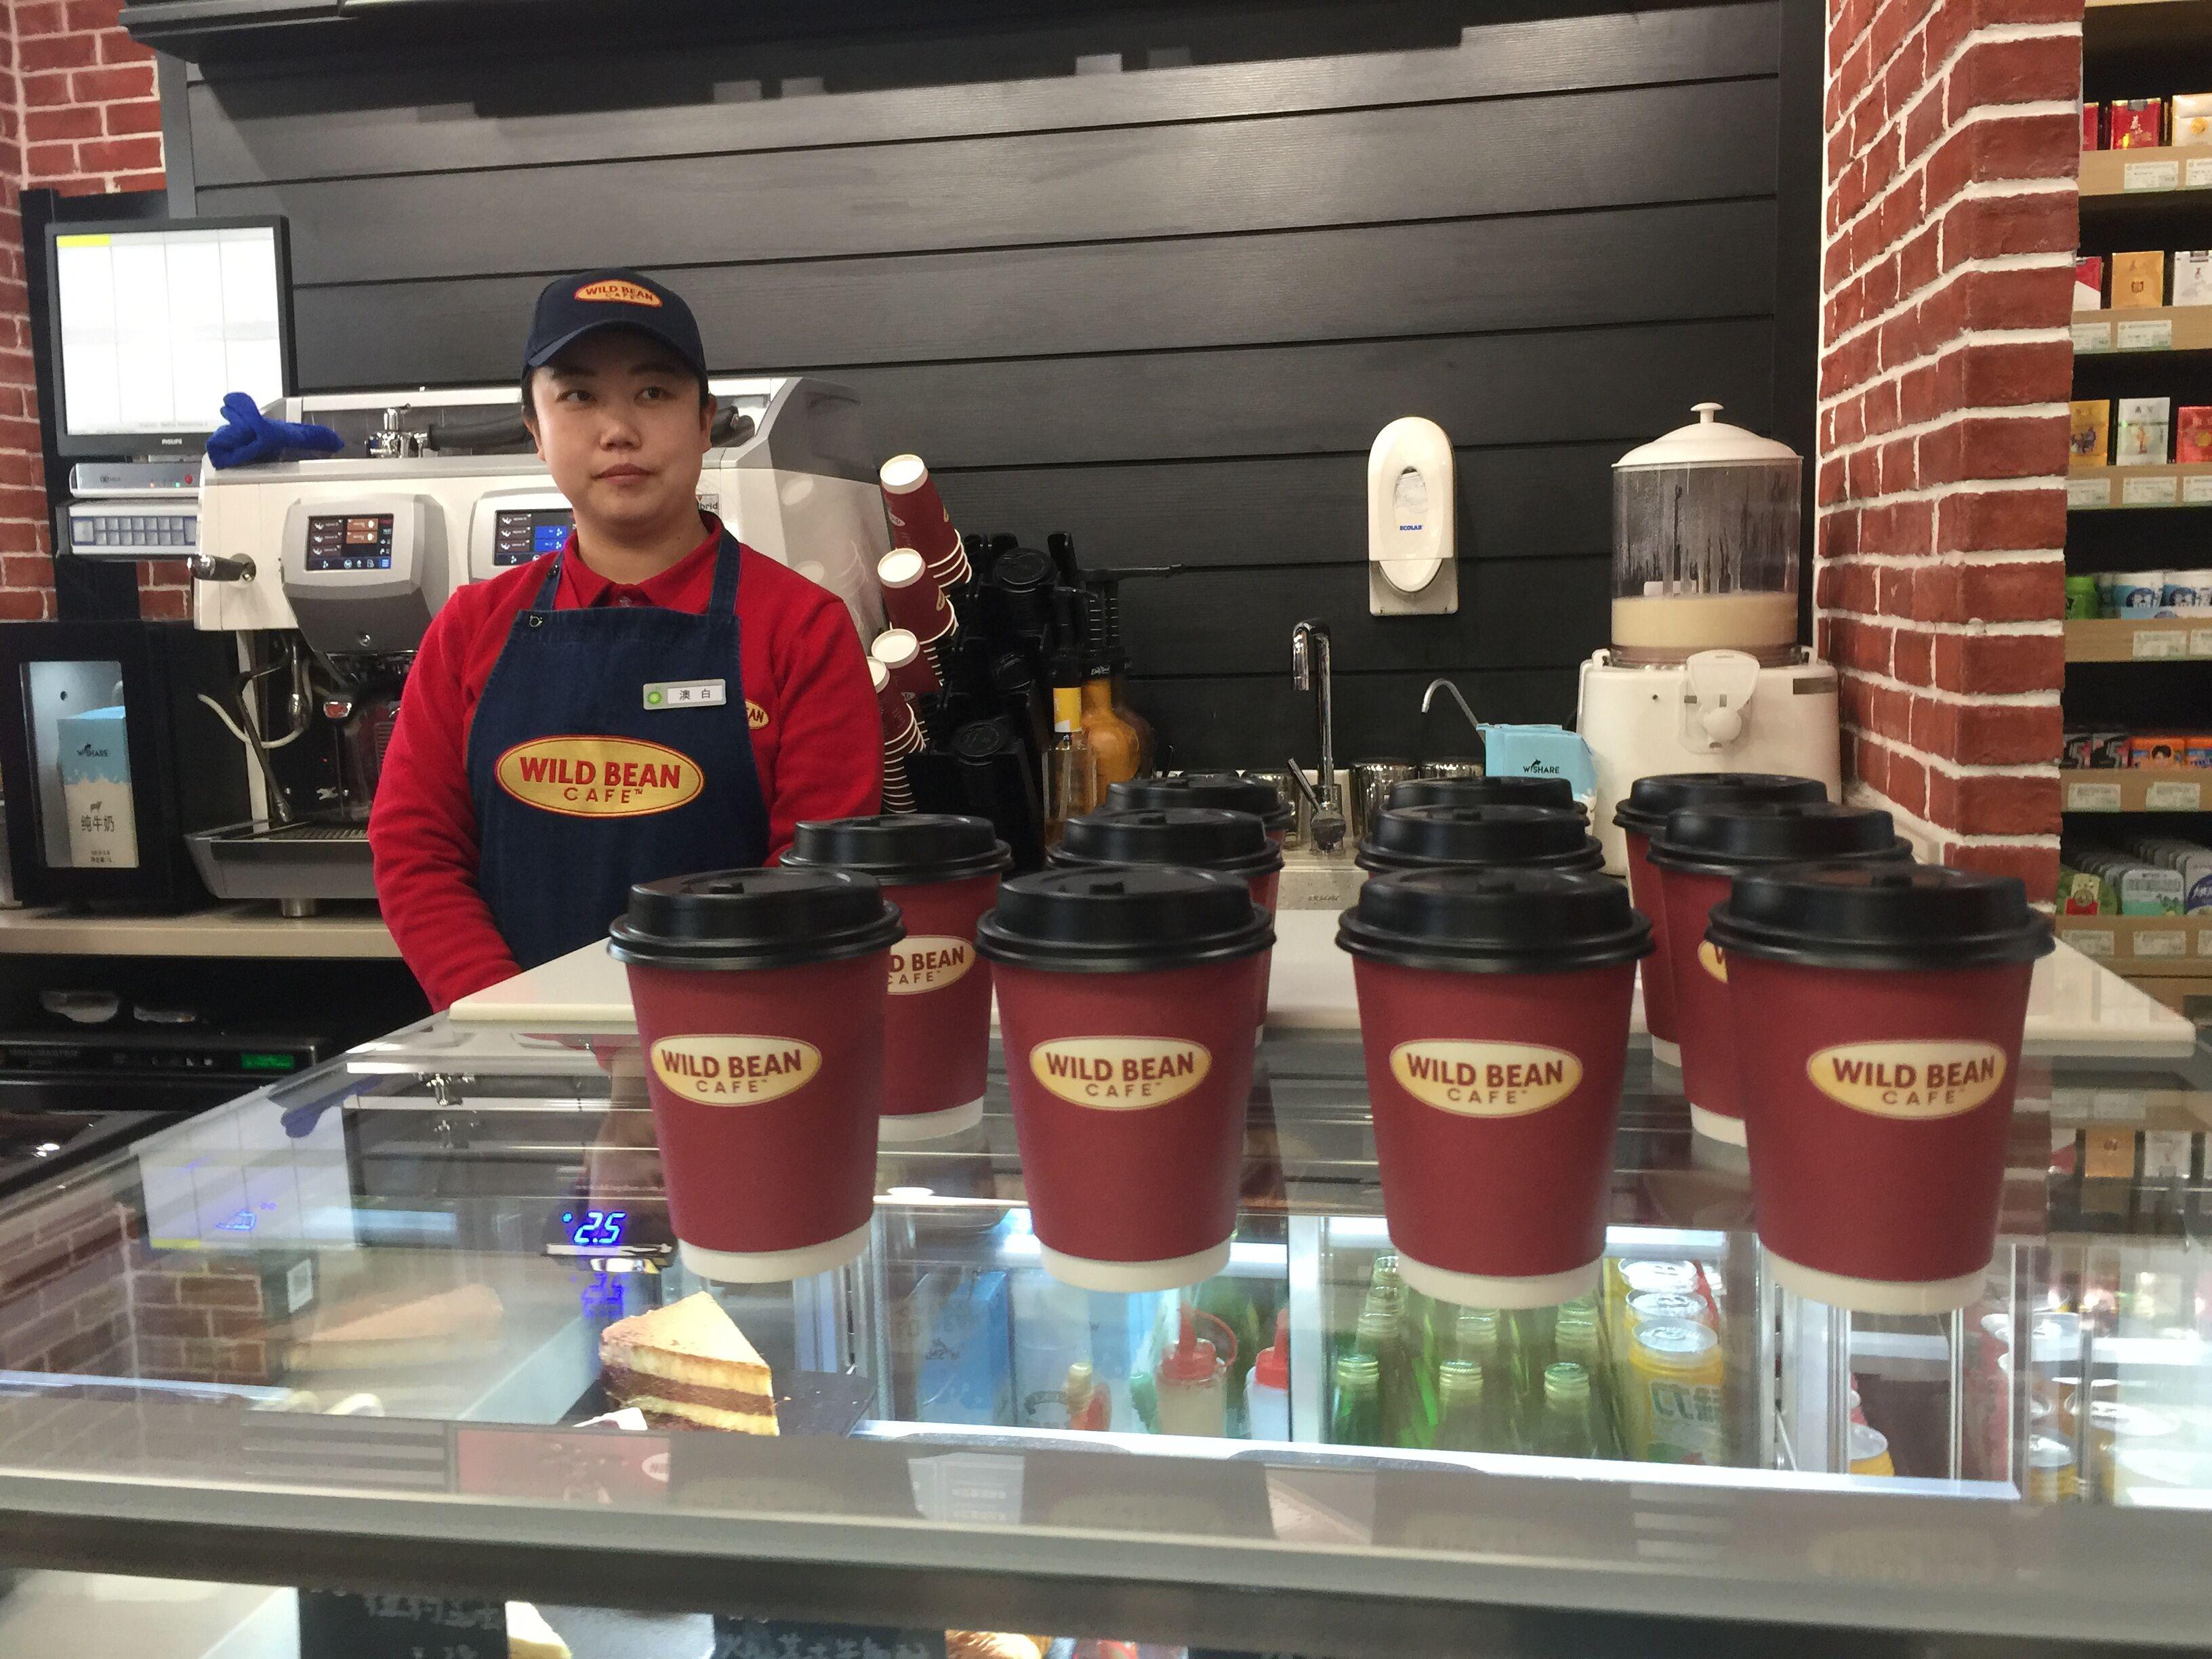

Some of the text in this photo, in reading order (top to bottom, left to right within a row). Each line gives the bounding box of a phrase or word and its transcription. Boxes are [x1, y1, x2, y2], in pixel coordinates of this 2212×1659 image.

[585, 286, 653, 301] WILD BEAN
[746, 708, 764, 723] AN
[519, 756, 681, 789] WILD BEAN
[81, 814, 115, 832] 纯牛奶
[912, 946, 964, 971] BEAN
[661, 1049, 802, 1078] WILD BEAN
[1045, 1051, 1194, 1082] WILD BEAN
[1406, 1052, 1563, 1088] WILD BEAN
[1832, 1054, 1995, 1089] WILD BEAN
[573, 1212, 626, 1244] 2.5
